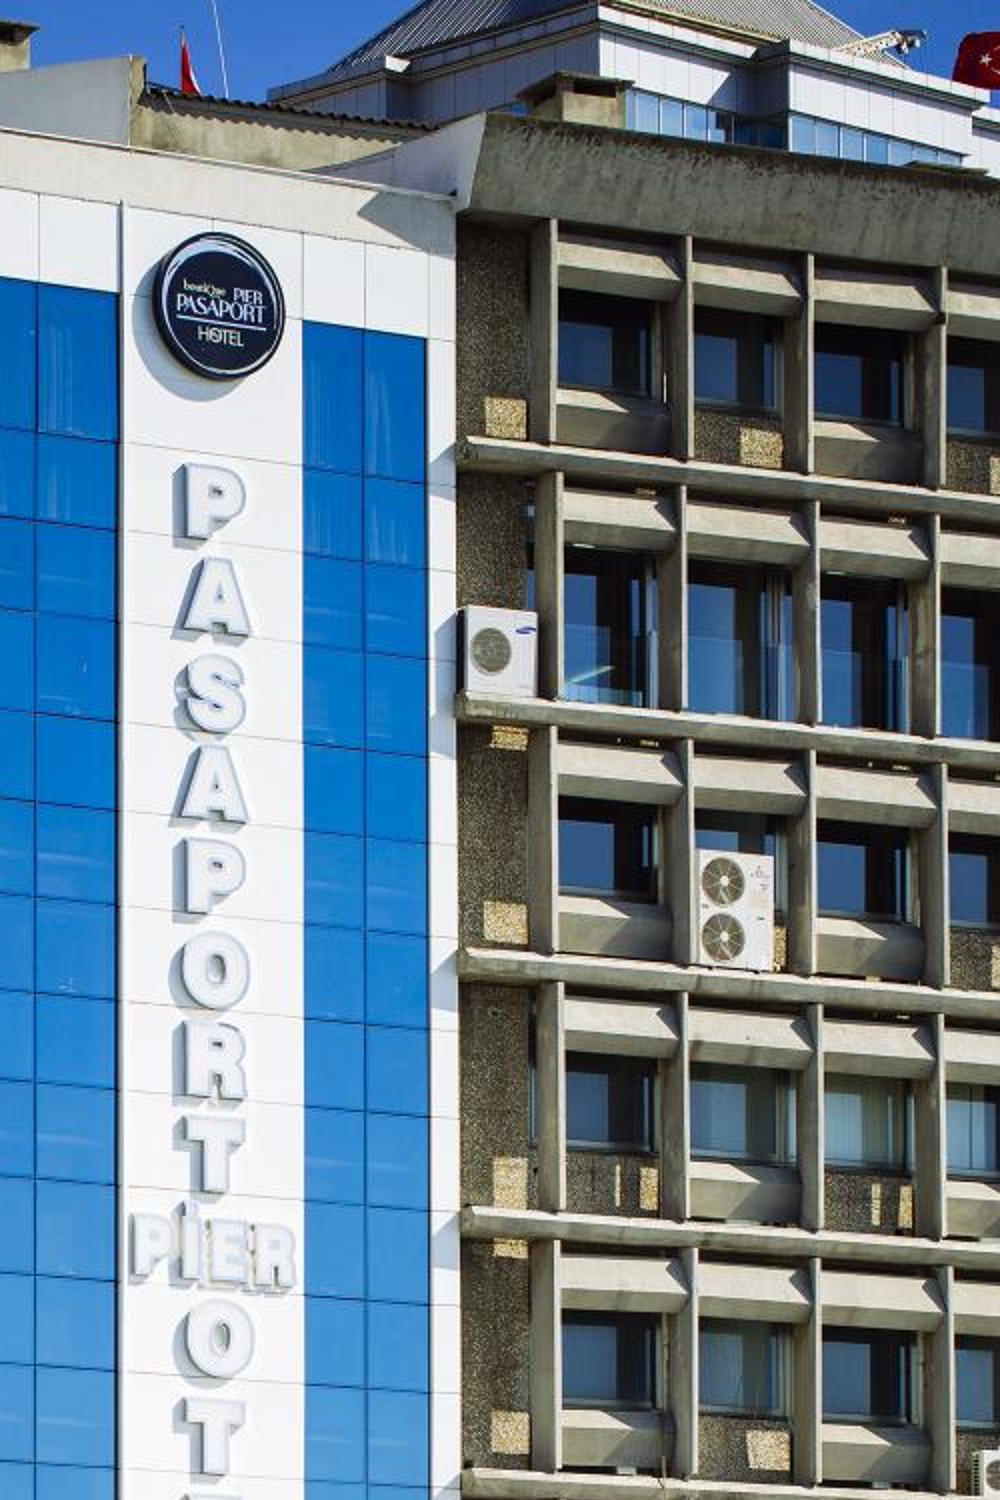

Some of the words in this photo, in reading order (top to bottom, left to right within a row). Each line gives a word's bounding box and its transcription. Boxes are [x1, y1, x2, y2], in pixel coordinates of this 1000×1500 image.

[177, 293, 266, 323] PASAPORT
[233, 287, 263, 305] PIER
[197, 325, 244, 347] HOTEL
[172, 463, 253, 1197] PASAPORT
